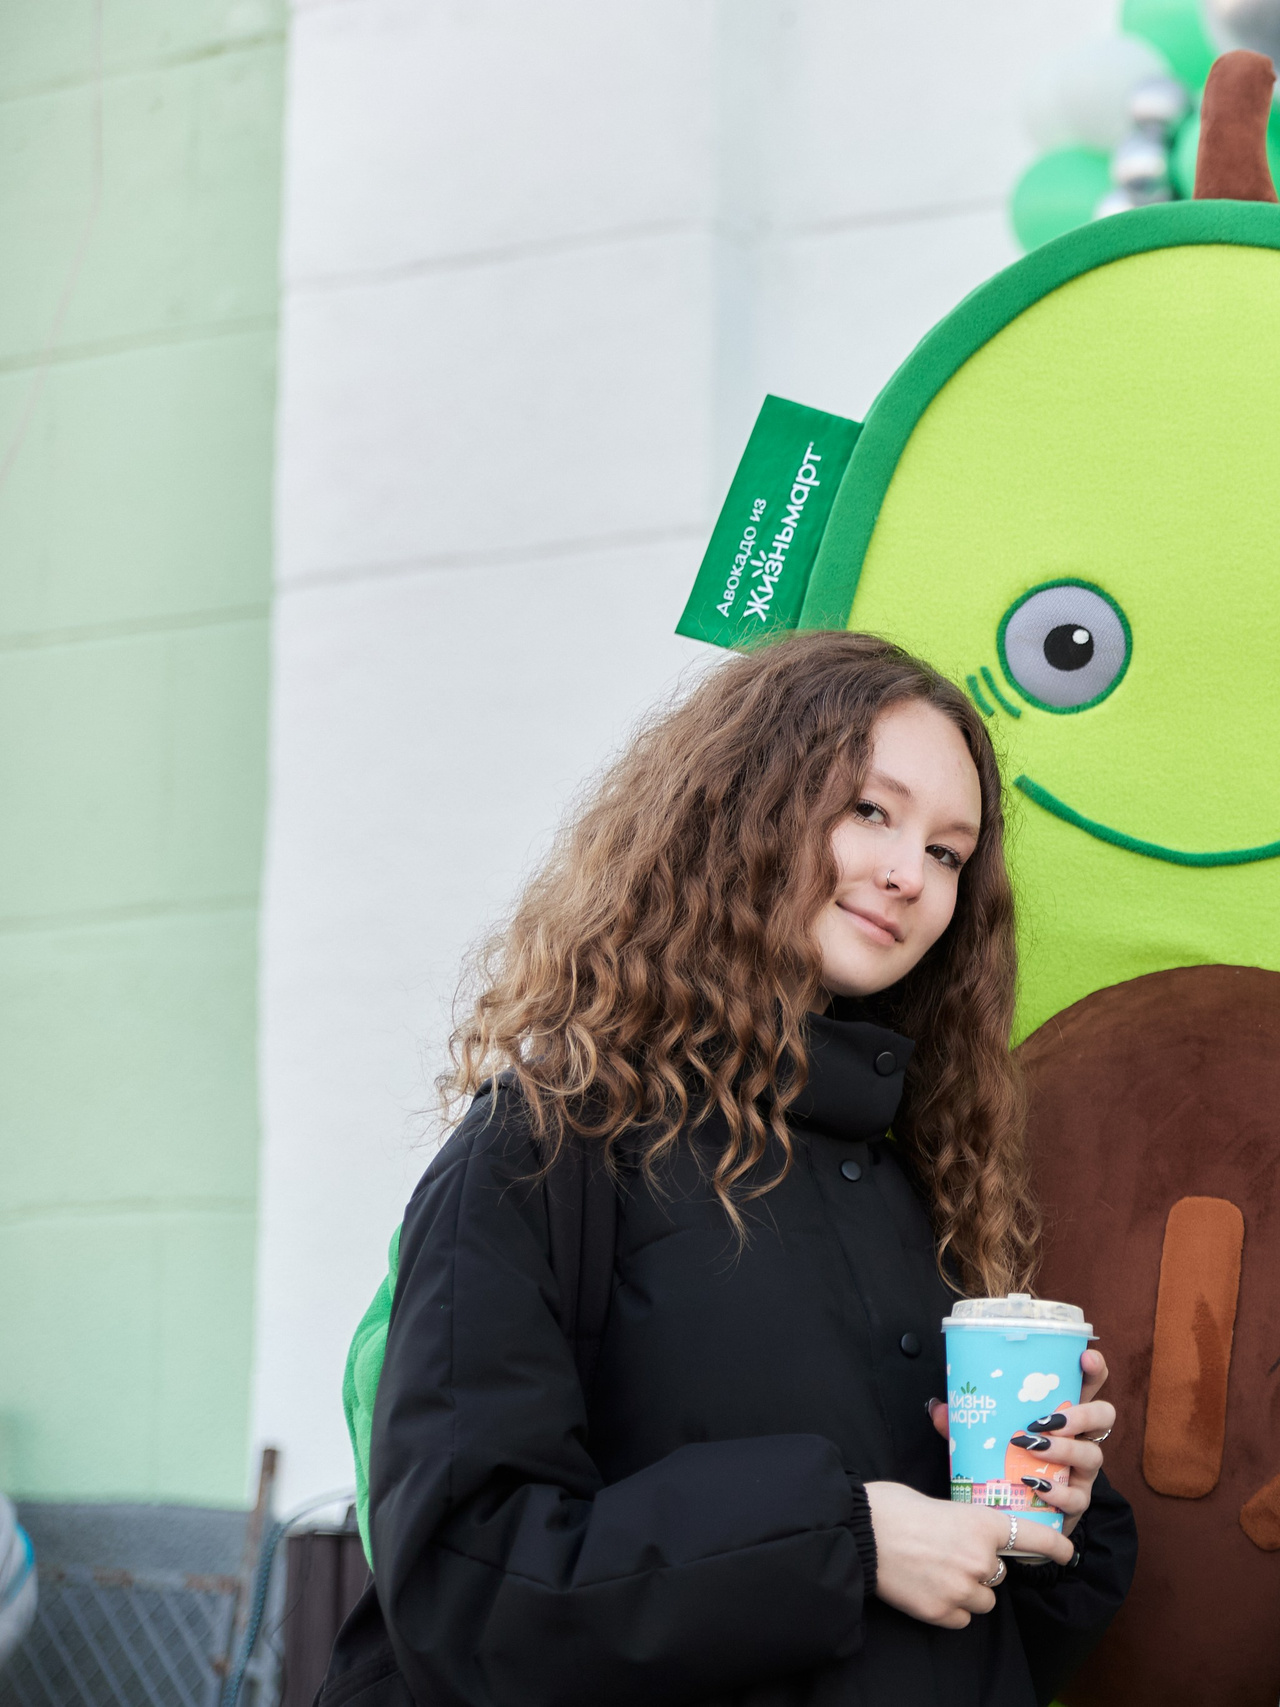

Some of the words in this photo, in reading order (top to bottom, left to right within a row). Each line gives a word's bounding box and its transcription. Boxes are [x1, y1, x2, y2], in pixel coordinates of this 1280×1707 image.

[716, 525, 757, 618] Авокадо
[750, 498, 767, 522] из
[743, 444, 822, 622] Жизньмарт
